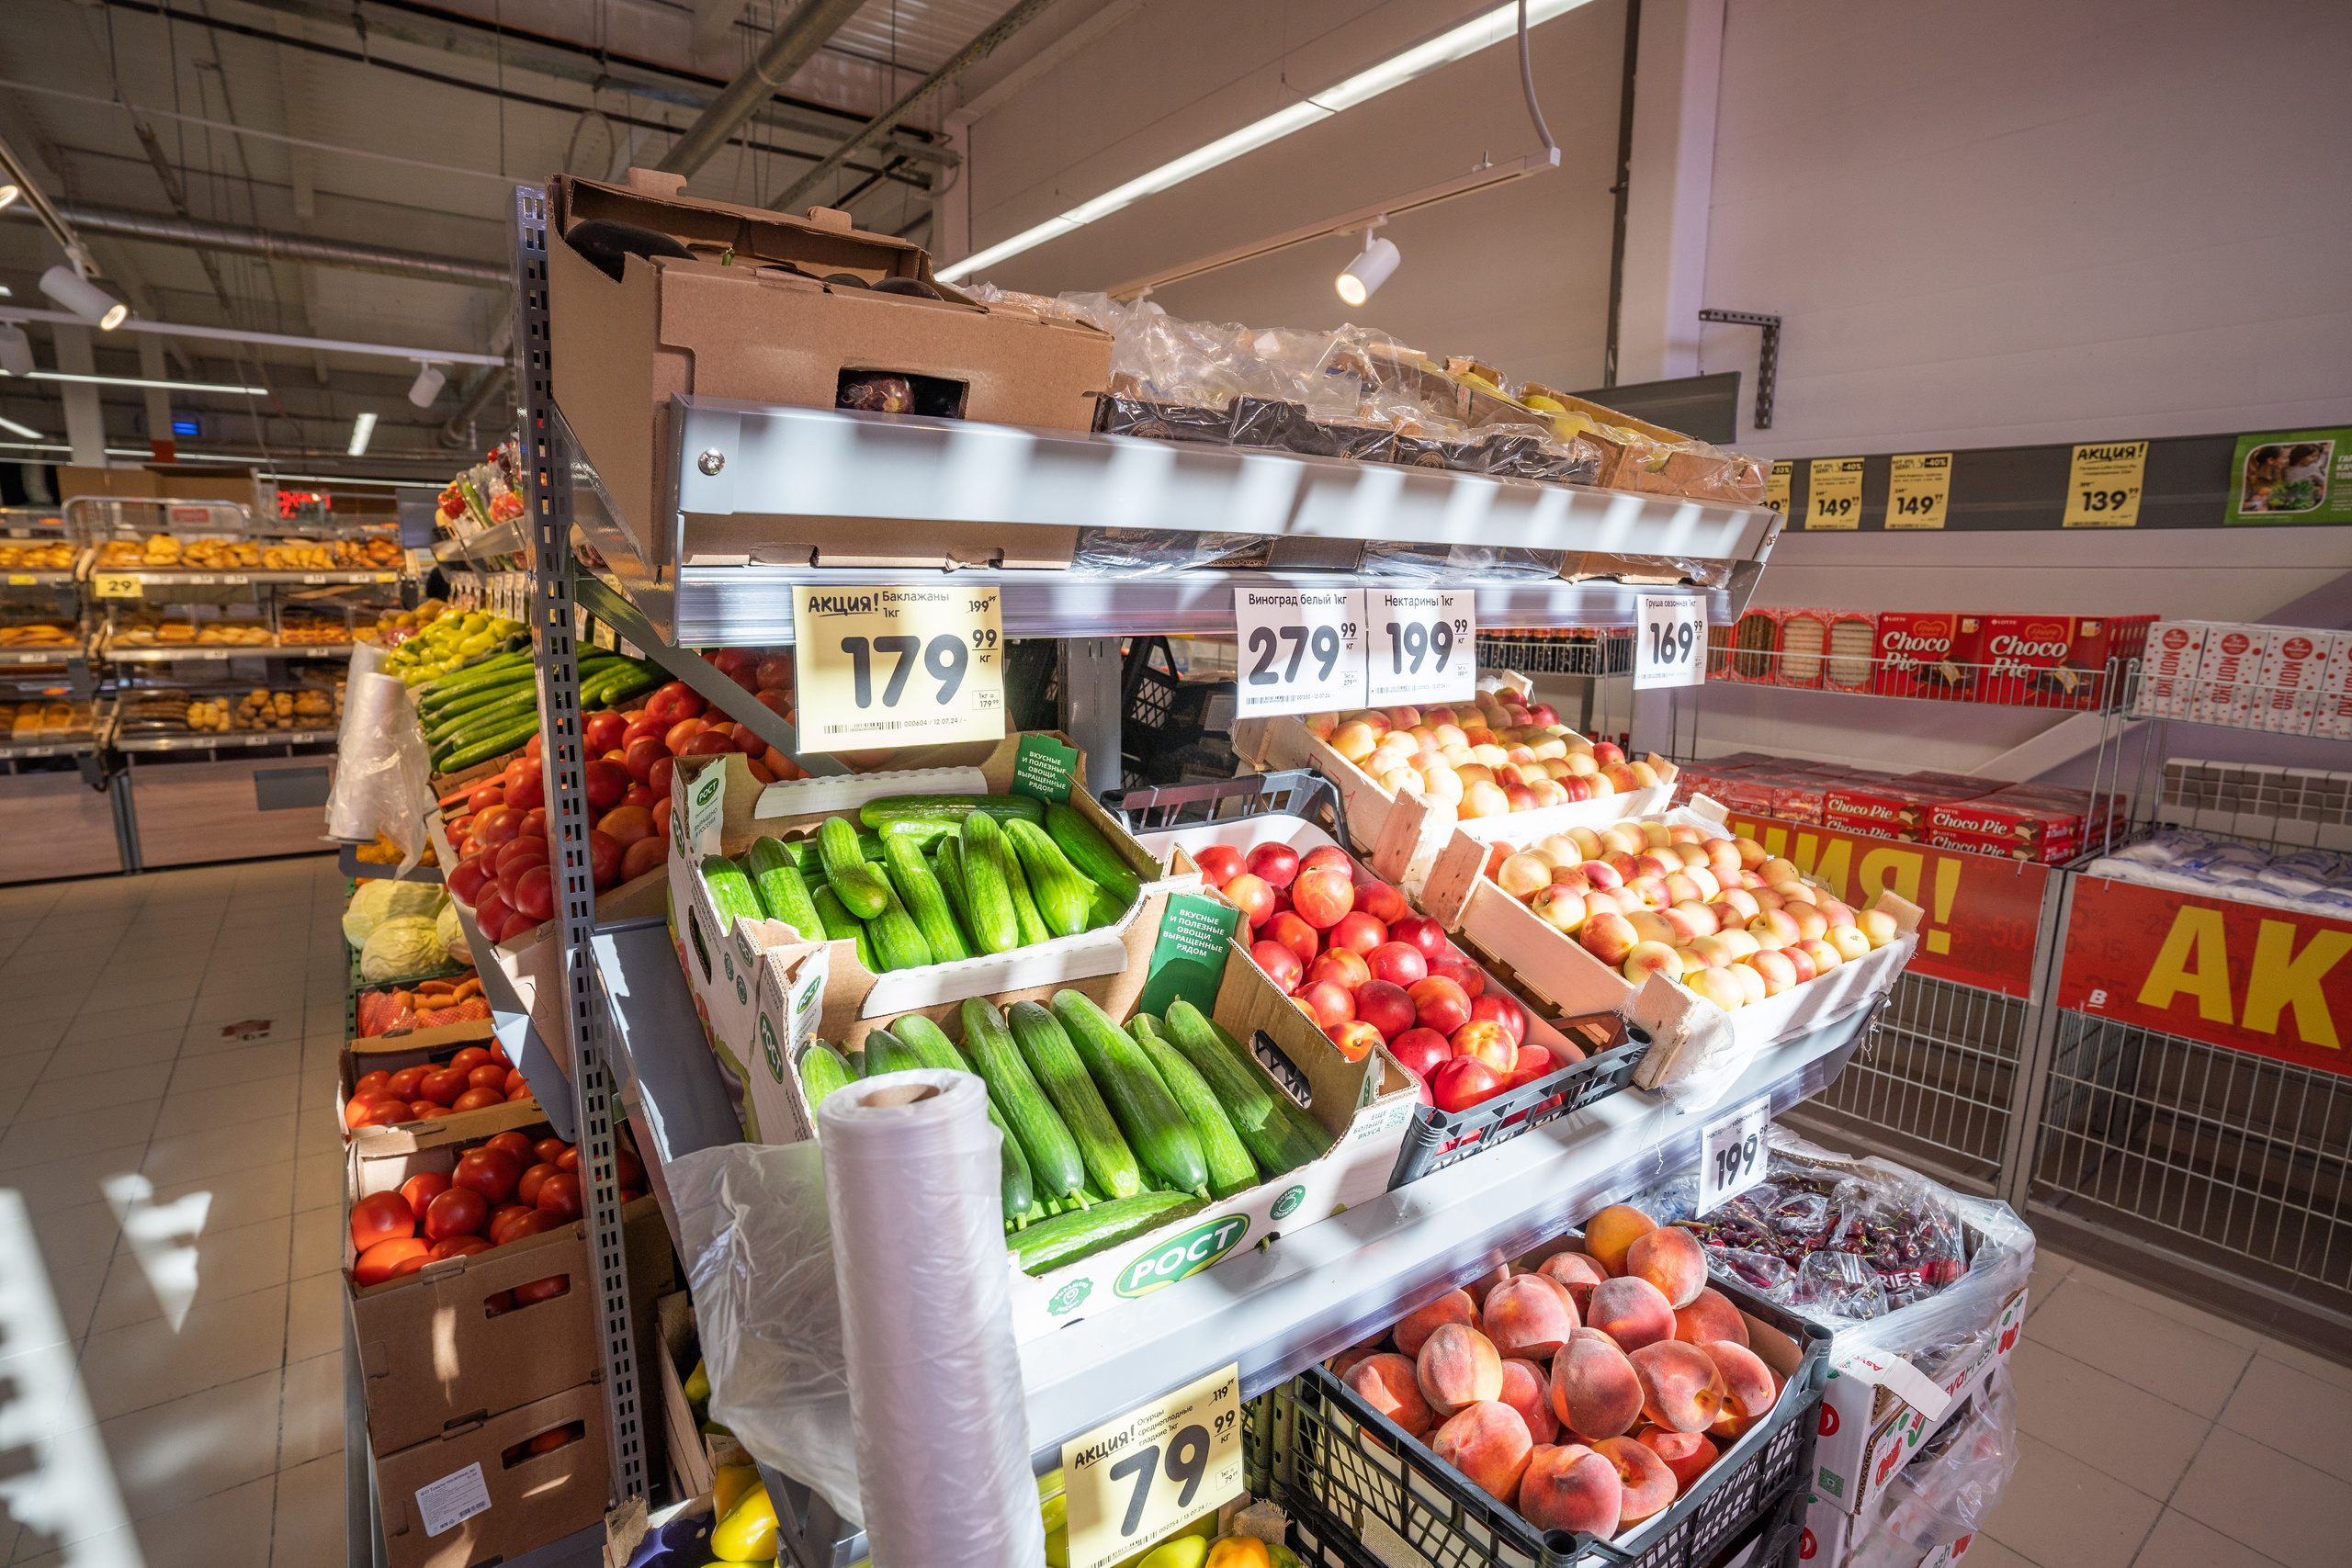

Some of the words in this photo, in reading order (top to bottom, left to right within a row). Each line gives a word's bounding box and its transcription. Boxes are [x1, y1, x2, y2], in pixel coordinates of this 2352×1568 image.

[2076, 443, 2145, 462] АКЦИЯ!
[1758, 500, 1781, 512] 9
[1818, 498, 1851, 516] 149
[1897, 496, 1934, 515] 149
[2082, 491, 2127, 511] 139
[108, 580, 132, 592] 29
[808, 592, 879, 616] АКЦИЯ!
[882, 591, 949, 604] Баклажаны
[968, 600, 989, 613] 199
[1249, 593, 1298, 607] Виноград
[1300, 593, 1331, 605] белый
[1334, 594, 1347, 604] 1кг
[1385, 594, 1439, 607] Нектарины
[1441, 594, 1453, 606] 1кг
[1646, 598, 1664, 609] Груша
[1689, 599, 1697, 607] 1кг
[884, 608, 900, 618] 1кг
[1346, 642, 1353, 650] кг
[1385, 621, 1453, 675] 199
[1454, 619, 1468, 633] 99
[1458, 637, 1464, 645] кг
[1650, 622, 1693, 665] 169
[1694, 620, 1703, 631] 99
[1883, 630, 1951, 653] Choco
[1989, 635, 2069, 658] Choco
[979, 655, 991, 663] кг
[1248, 625, 1340, 685] 279
[1340, 622, 1357, 638] 99
[1881, 651, 1919, 671] Pie
[841, 634, 968, 709] 179
[972, 628, 997, 649] 99
[1989, 657, 2032, 679] Pie
[1028, 758, 1067, 774] ПОЛЕЗНЫЕ
[1029, 750, 1062, 766] ВКУСНЫЕ
[1017, 770, 1066, 790] ВЫРАЩЕННЫЕ
[1028, 766, 1057, 781] ОВОЩИ,
[698, 780, 718, 803] РОСТ
[1028, 780, 1054, 794] РЯДОМ
[1834, 793, 1850, 801] LOTTE
[1827, 799, 1869, 817] Choco
[1868, 805, 1894, 820] Pie
[1939, 807, 1960, 815] LOTTE
[1826, 820, 1867, 835] Choco
[1868, 827, 1892, 839] Pie
[1932, 813, 1980, 831] Choco
[1980, 818, 2008, 837] Pie
[1931, 835, 1977, 852] Choco
[1977, 841, 2006, 858] Pie
[1170, 915, 1178, 923] И
[1178, 917, 1226, 936] ПОЛЕЗНЫЕ
[1179, 908, 1220, 926] ВКУСНЫЕ
[1162, 931, 1224, 954] ВЫРАЩЕННЫЕ
[1177, 925, 1213, 942] ОВОЩИ,
[737, 935, 752, 964] РОСТ
[1176, 942, 1208, 957] РЯДОМ
[2137, 906, 2352, 1050] АК
[799, 978, 820, 1010] РОСТ
[762, 1022, 782, 1075] РОСТ
[1372, 1109, 1388, 1120] ЕЩЕ
[1353, 1118, 1385, 1134] БОЛЬШЕ
[1358, 1127, 1381, 1140] ВКУСА
[1716, 1134, 1758, 1191] 199
[1759, 1123, 1769, 1137] 99
[1129, 1221, 1239, 1289] РОСТ
[1137, 1404, 1193, 1437] среднеплодные
[1074, 1424, 1136, 1470] АКЦИЯ!
[1137, 1408, 1165, 1427] Огурцы
[1138, 1428, 1168, 1447] гладкие
[1169, 1421, 1179, 1436] 1кг
[1220, 1433, 1231, 1445] кг
[1110, 1424, 1211, 1538] 79
[1215, 1410, 1236, 1434] 99
[1225, 1474, 1233, 1484] 79
[1159, 1518, 1180, 1534] 002754
